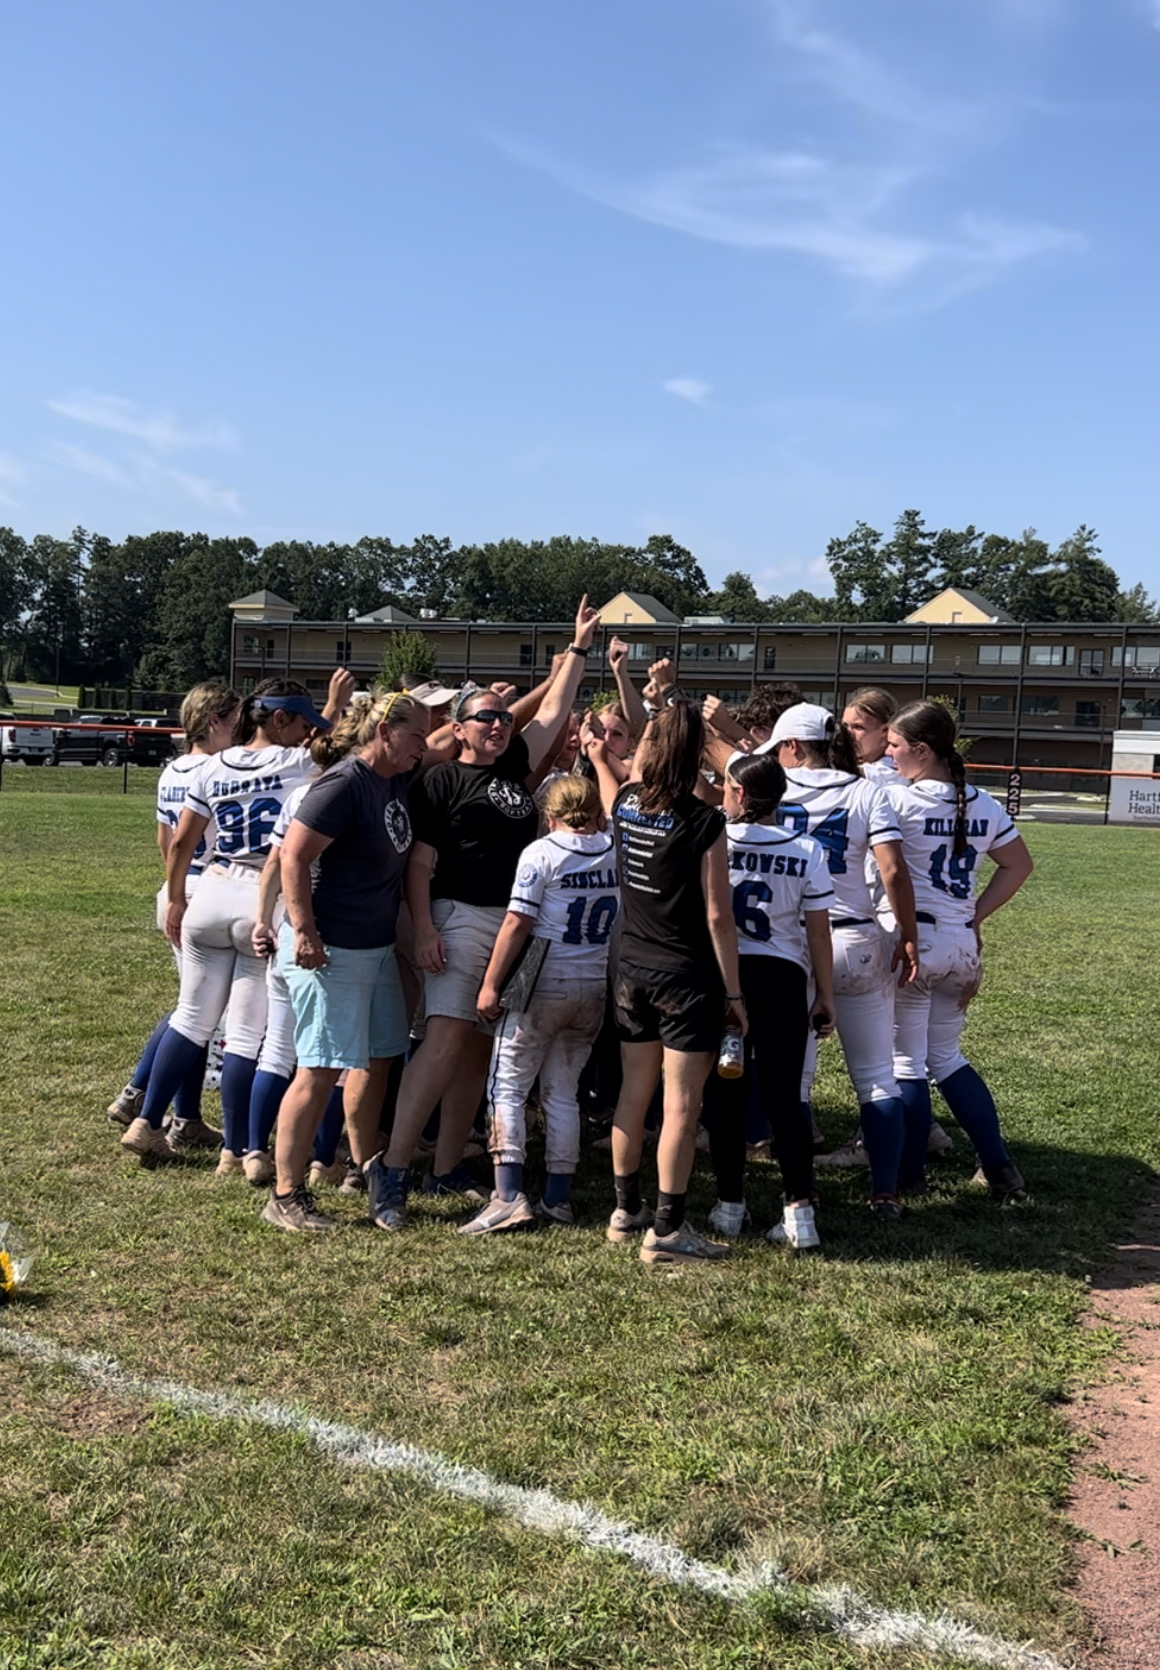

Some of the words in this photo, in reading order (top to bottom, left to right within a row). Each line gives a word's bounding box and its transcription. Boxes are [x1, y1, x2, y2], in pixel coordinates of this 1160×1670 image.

[1007, 773, 1021, 814] 225
[729, 851, 808, 878] KOWSKI
[928, 844, 978, 900] 19
[562, 896, 618, 945] 10
[732, 880, 773, 942] 6
